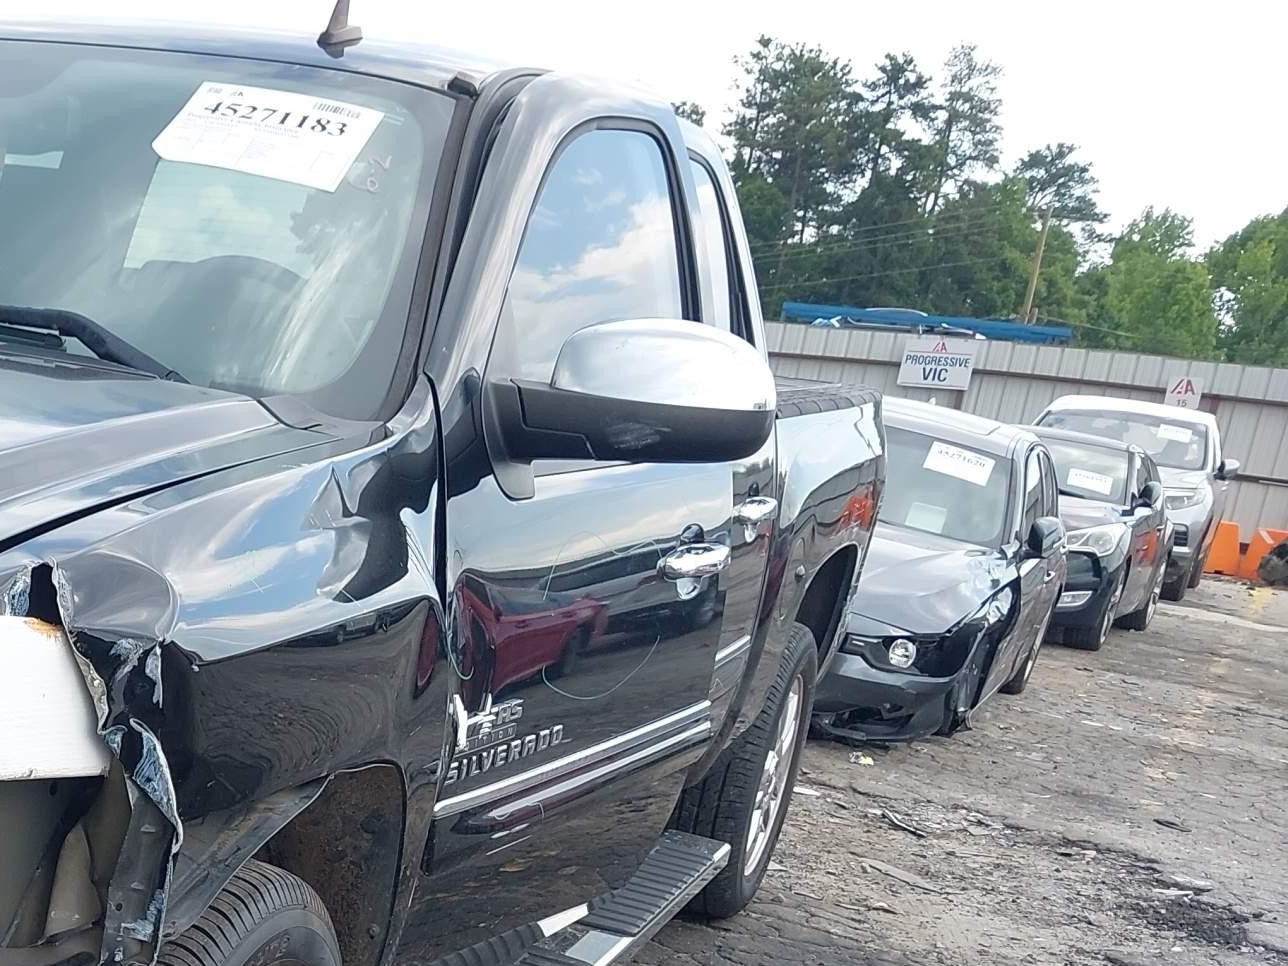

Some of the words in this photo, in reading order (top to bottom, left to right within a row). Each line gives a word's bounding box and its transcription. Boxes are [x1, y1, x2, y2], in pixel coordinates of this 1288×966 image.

[204, 101, 349, 138] 45271183
[904, 354, 971, 368] PROGRESSIVE
[921, 367, 949, 382] VIC
[444, 724, 564, 785] SILVERADO
